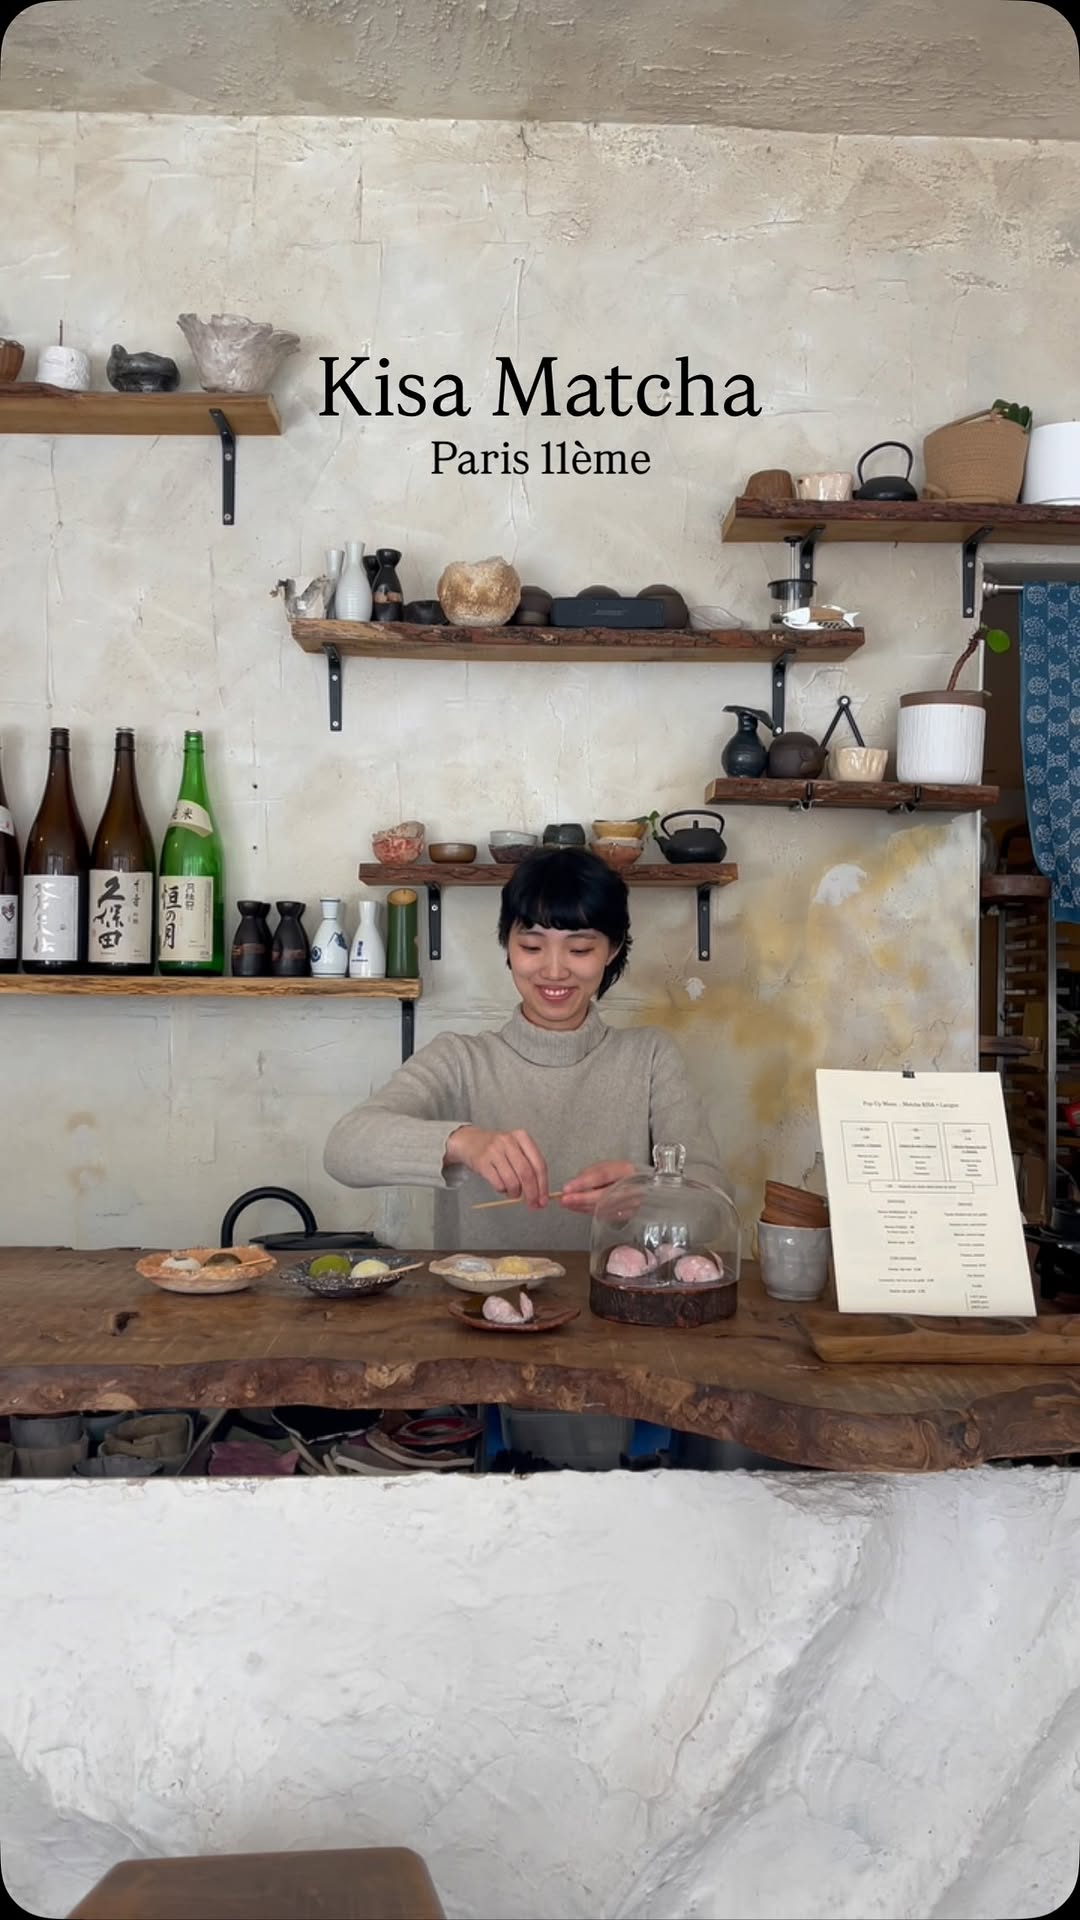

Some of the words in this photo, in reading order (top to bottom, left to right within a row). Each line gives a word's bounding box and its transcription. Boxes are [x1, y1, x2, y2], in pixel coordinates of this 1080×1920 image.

[93, 876, 125, 949] 久保田
[162, 884, 182, 949] 恒の月
